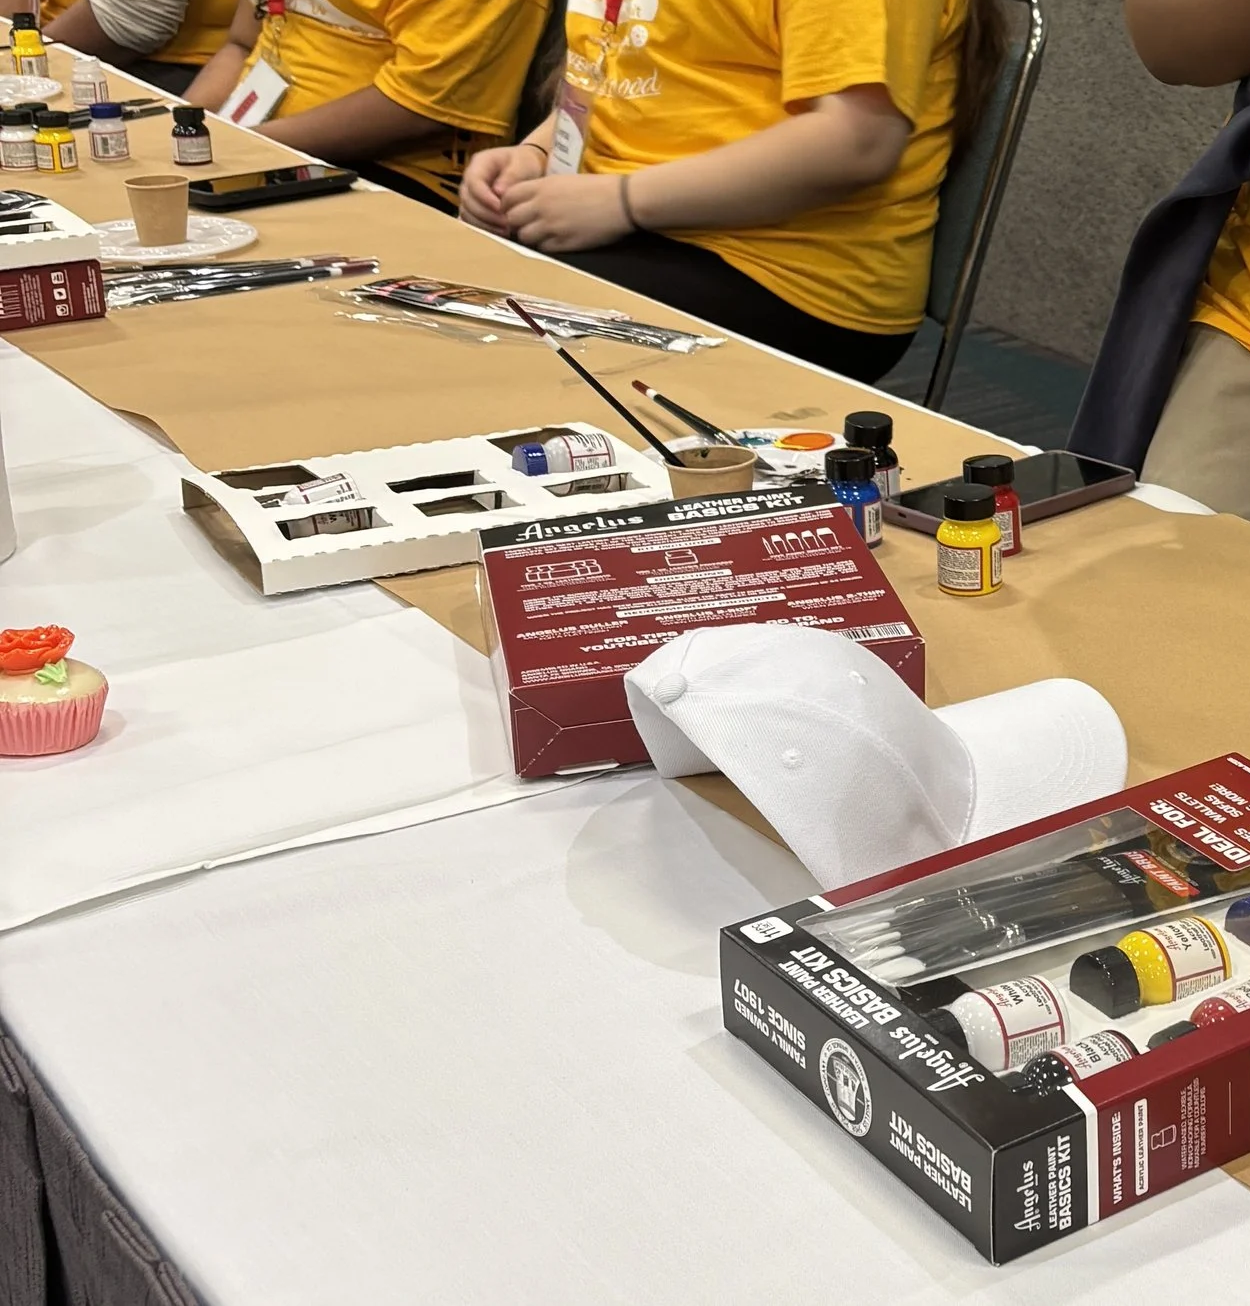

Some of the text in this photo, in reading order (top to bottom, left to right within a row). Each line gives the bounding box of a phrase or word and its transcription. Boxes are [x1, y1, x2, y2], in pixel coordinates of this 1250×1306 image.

[668, 496, 805, 522] BASICS KIT
[674, 492, 792, 512] LEATHER PAINT
[516, 515, 644, 542] Angelus
[604, 636, 637, 644] FOR
[641, 631, 678, 639] TIPS
[1150, 800, 1196, 828] FOR:
[1174, 792, 1226, 823] WALLETS
[1204, 795, 1243, 817] SOFAS
[1209, 783, 1248, 805] MORE!
[1149, 870, 1188, 890] PAINT
[790, 946, 834, 972] KIT
[1166, 924, 1192, 951] Yellow
[734, 979, 805, 1050] SINCE 1907
[778, 961, 870, 1029] LEATHER PAINT
[822, 968, 901, 1024] BASICS
[734, 998, 806, 1069] FAMILY OWNED
[889, 1026, 985, 1092] Angelus
[889, 1111, 971, 1194] BASICS KIT
[890, 1132, 971, 1212] LEATHER PAINT
[1112, 1112, 1122, 1204] WHAT'S INSIDE:
[1014, 1160, 1041, 1232] Angelus
[1047, 1147, 1057, 1228] LEATHER PAINT
[1057, 1135, 1071, 1230] BASICS KIT
